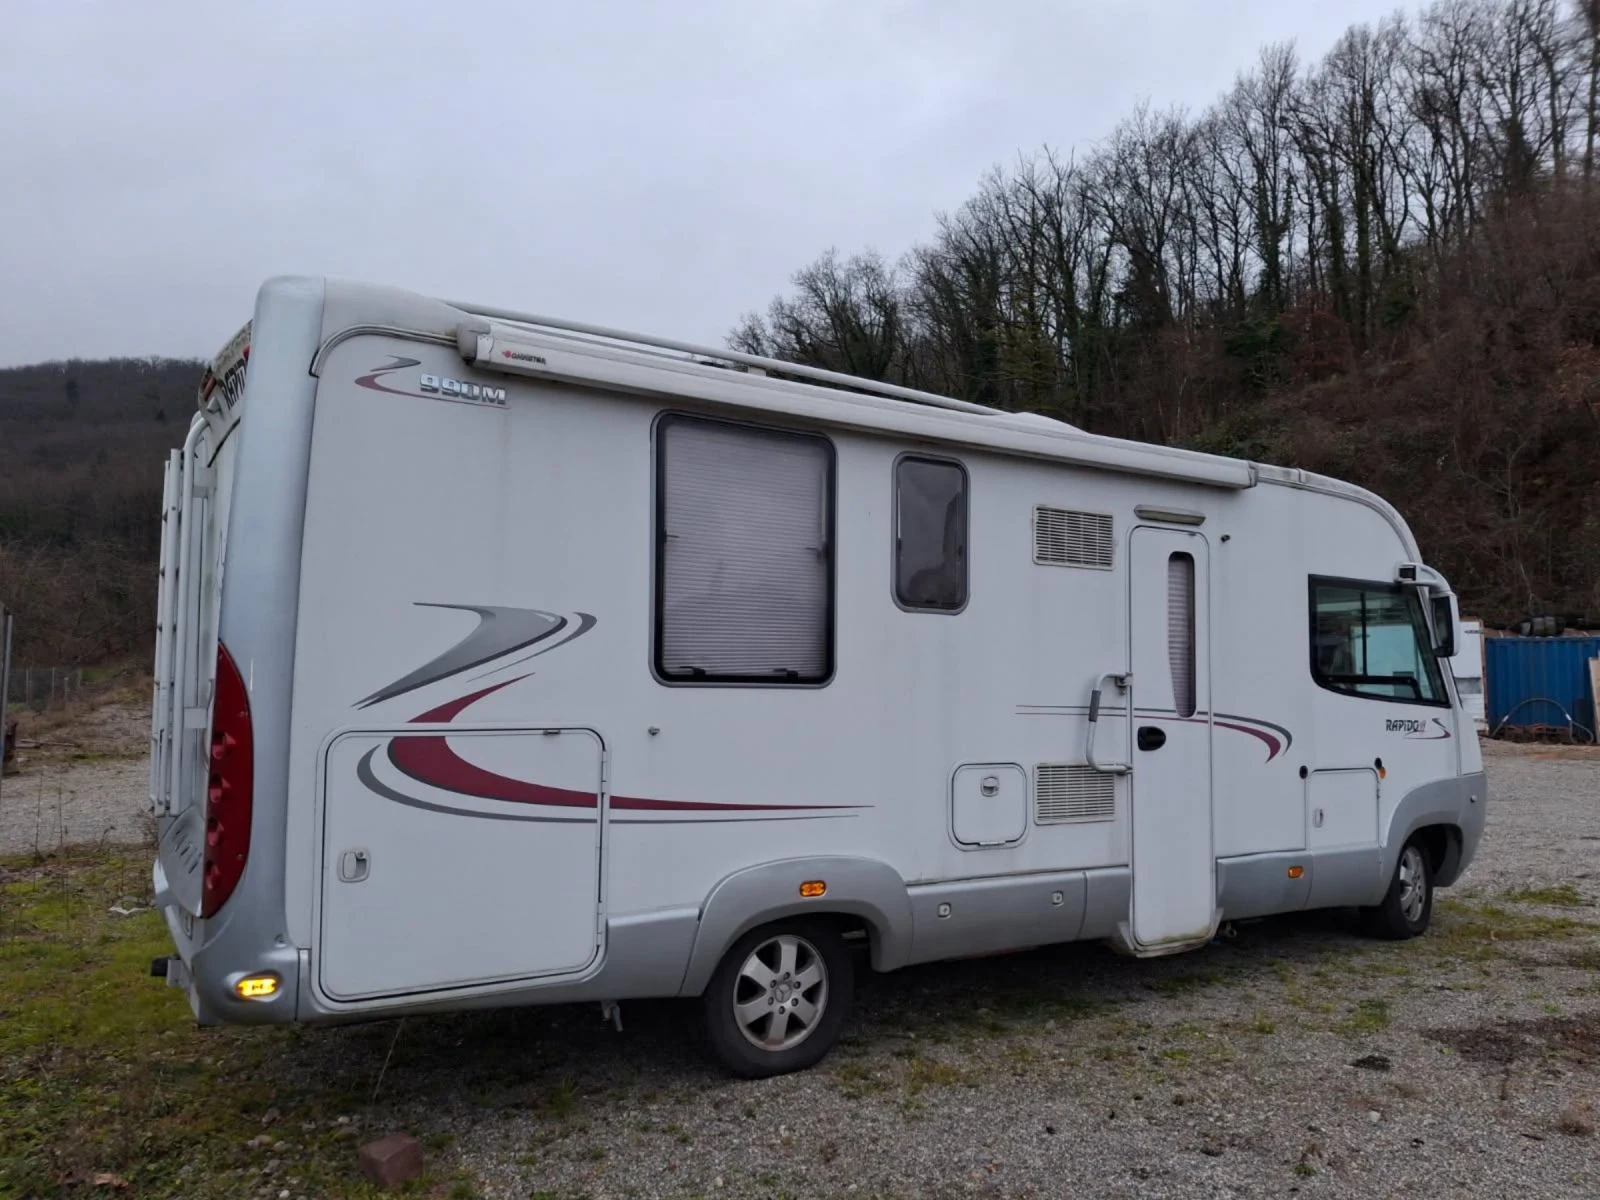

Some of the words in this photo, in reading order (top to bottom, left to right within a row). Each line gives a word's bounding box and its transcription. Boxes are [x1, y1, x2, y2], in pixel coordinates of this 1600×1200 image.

[218, 357, 247, 411] RAPID
[419, 373, 506, 406] 990M
[1385, 718, 1420, 732] RAPIDO
